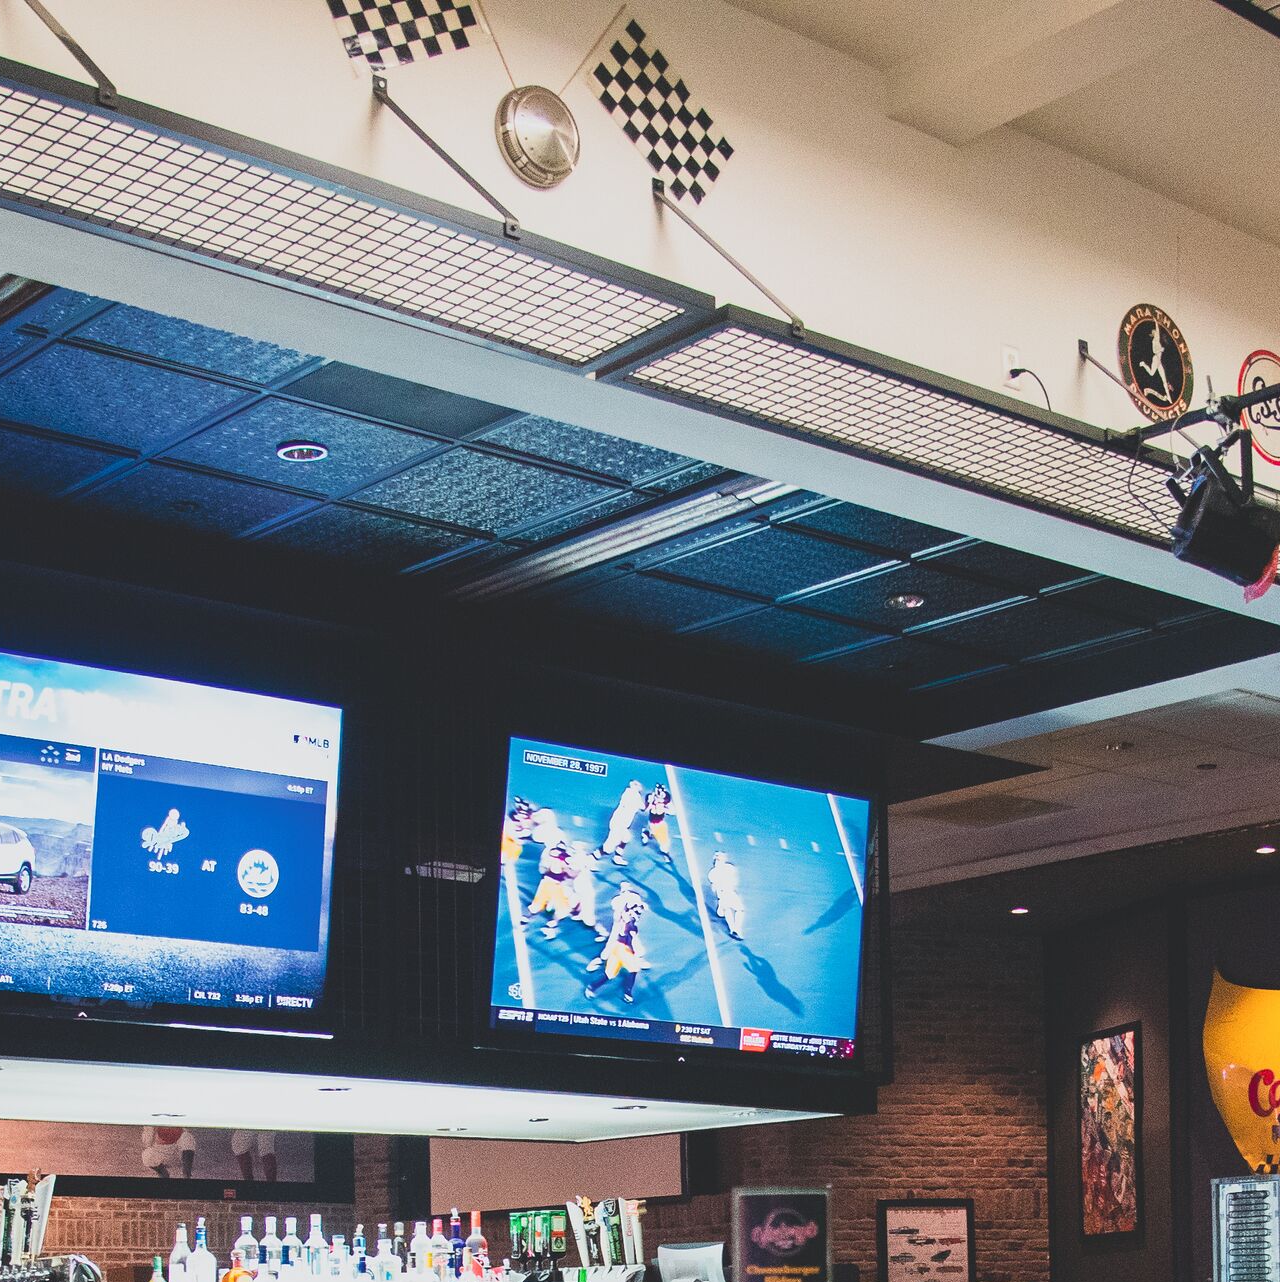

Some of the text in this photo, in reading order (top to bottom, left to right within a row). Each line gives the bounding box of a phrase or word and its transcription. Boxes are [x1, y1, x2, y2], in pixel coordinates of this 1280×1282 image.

[1123, 306, 1188, 354] MARATHON
[309, 737, 329, 748] MLB
[102, 752, 145, 767] LA Dodgers
[526, 753, 604, 773] NOVEMBER 28, 1997
[149, 859, 217, 875] 90-39 AT
[0, 975, 14, 984] ATL
[276, 995, 313, 1008] DIRECTV
[573, 1015, 589, 1025] Utah
[590, 1017, 608, 1026] State
[621, 1020, 649, 1030] Alabama
